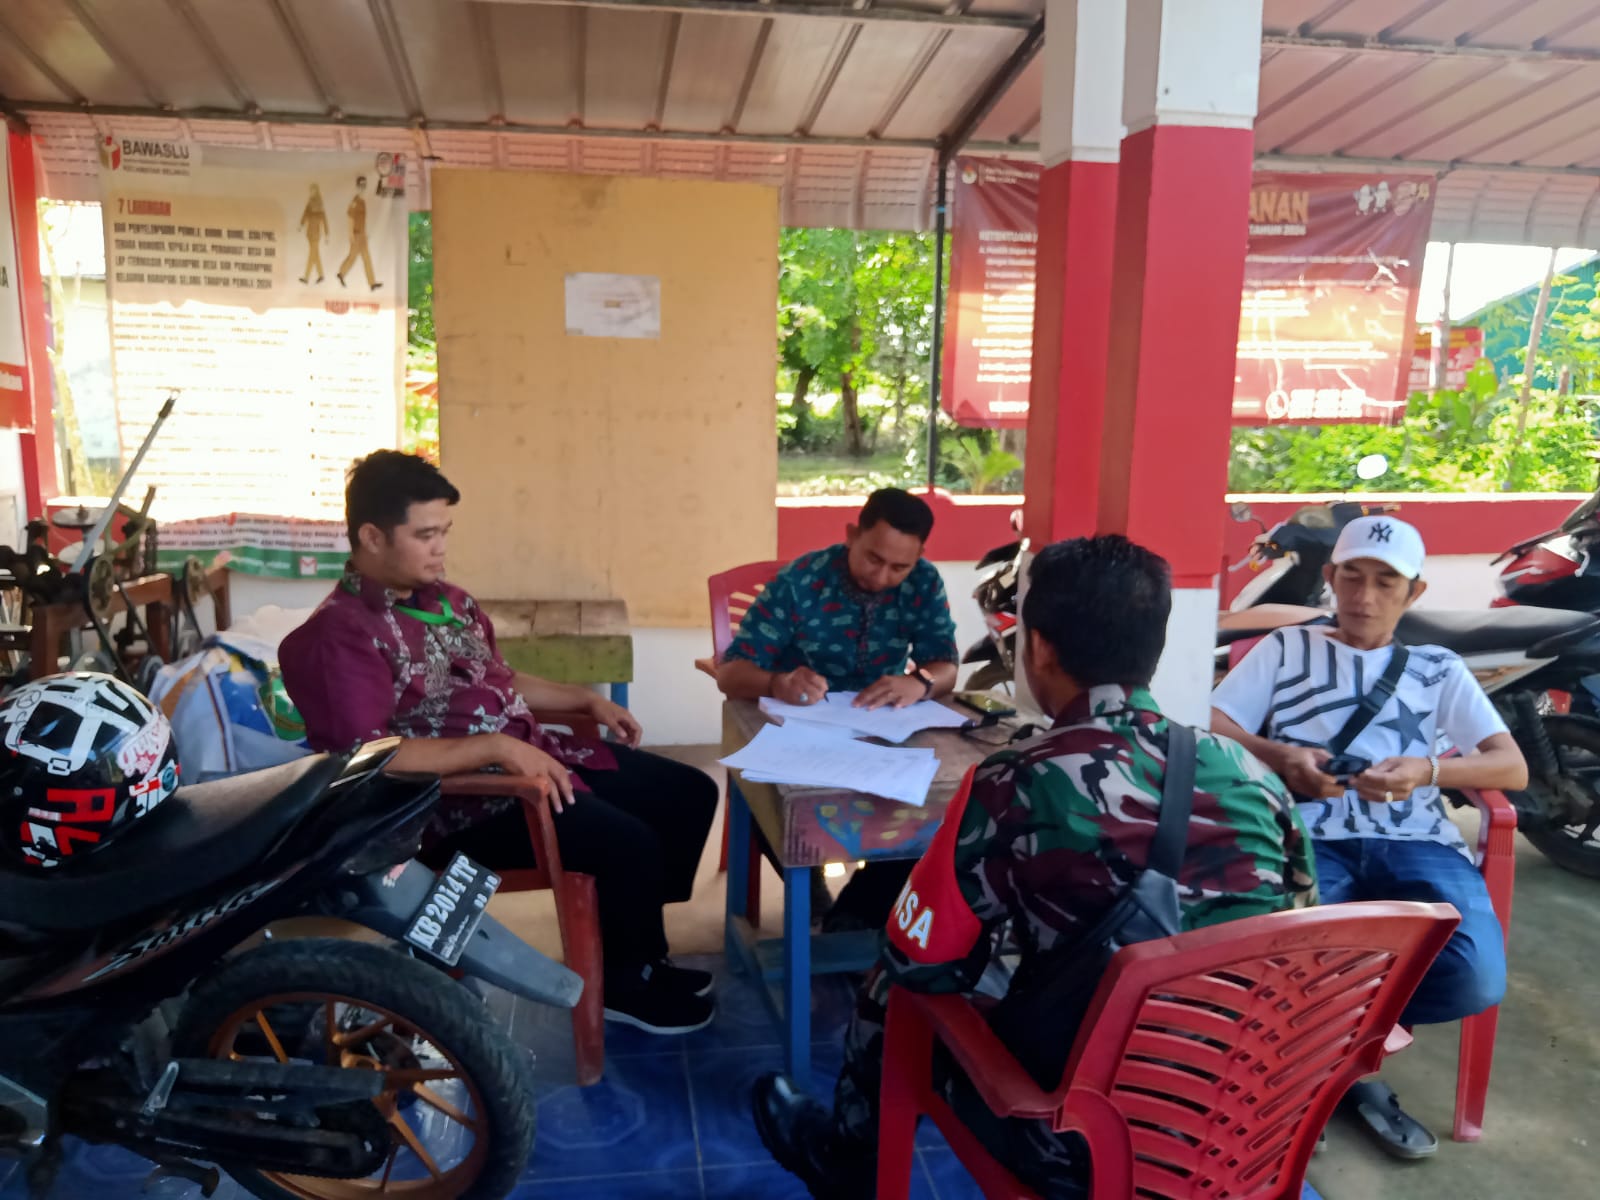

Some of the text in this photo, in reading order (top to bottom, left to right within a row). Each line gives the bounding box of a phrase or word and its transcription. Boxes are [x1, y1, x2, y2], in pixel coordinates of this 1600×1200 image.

[122, 140, 190, 159] BAWASLU
[1368, 523, 1393, 543] NY
[425, 875, 467, 924] 2014
[409, 915, 442, 950] KB
